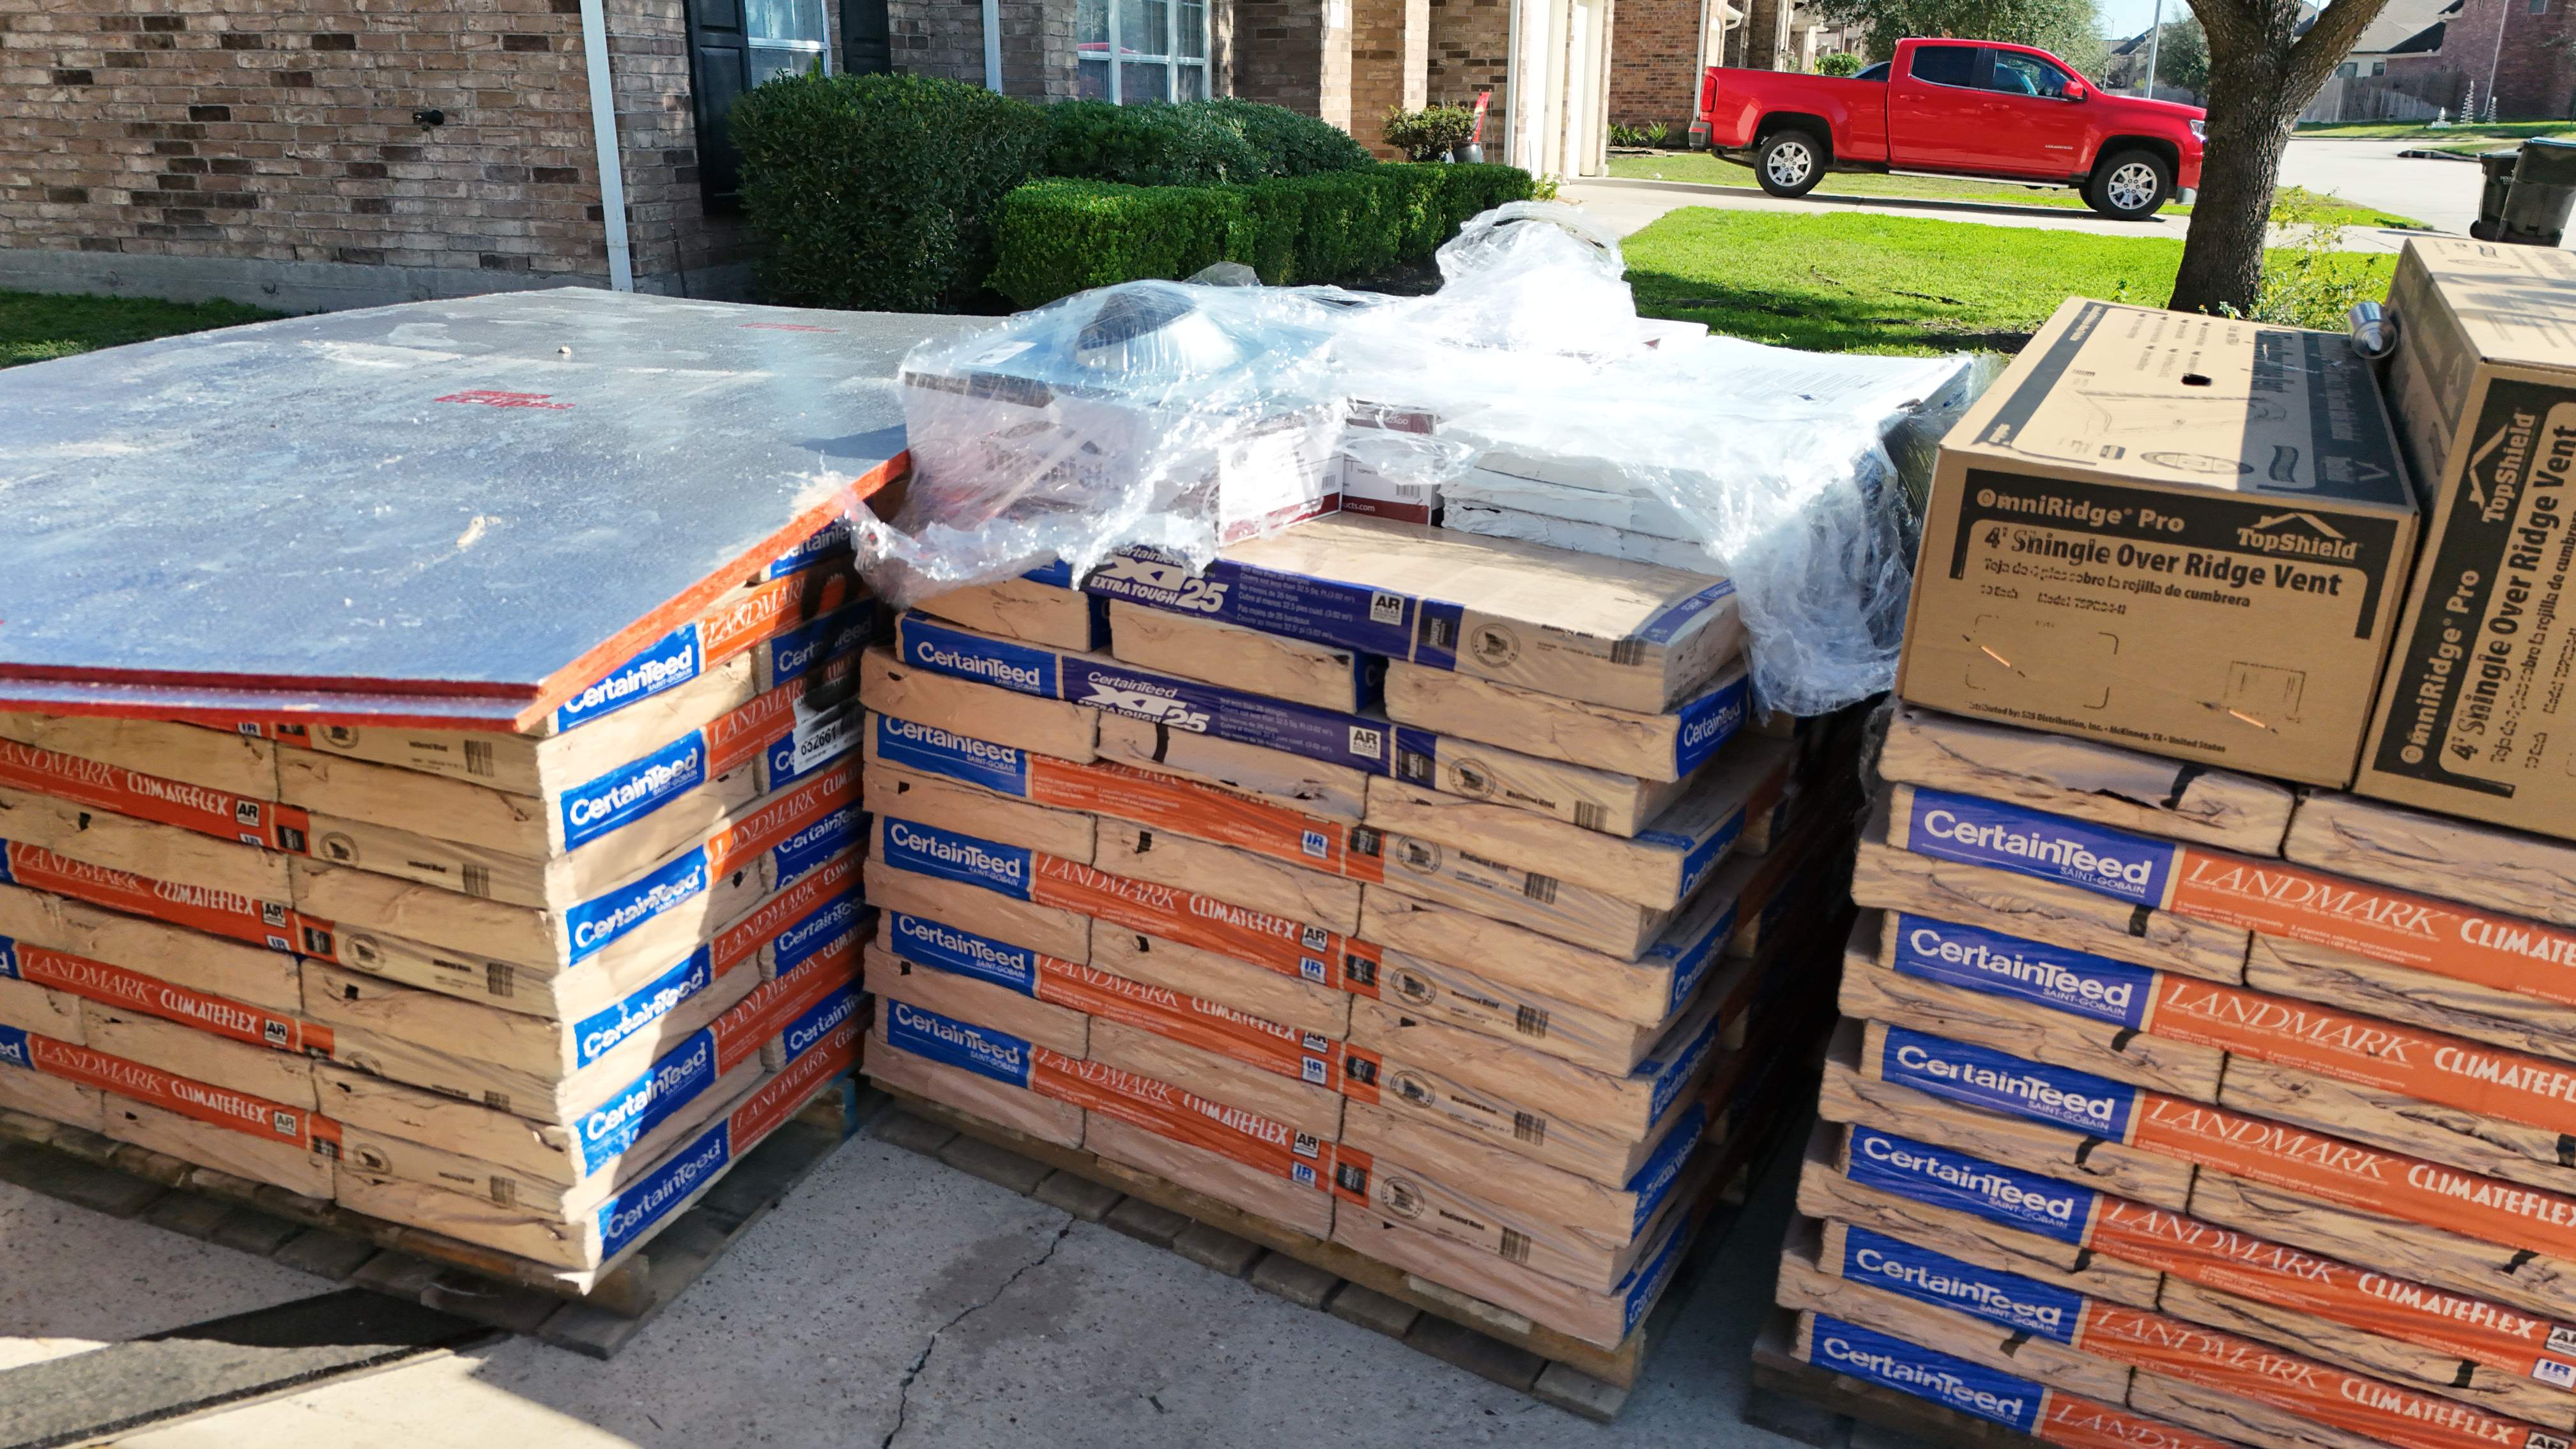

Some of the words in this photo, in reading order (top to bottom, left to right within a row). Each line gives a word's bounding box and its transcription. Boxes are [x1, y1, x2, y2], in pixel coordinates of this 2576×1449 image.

[2481, 412, 2536, 524] TopShield
[2533, 424, 2576, 489] Vent
[2138, 509, 2185, 533] Pro
[2237, 527, 2358, 561] TopShield
[2508, 496, 2559, 572] Ridge
[2013, 528, 2110, 569] Shingle
[2117, 543, 2179, 573] Over
[2184, 551, 2267, 589] Ridge
[2273, 564, 2343, 597] Vent
[2446, 571, 2480, 614] Pro
[2546, 574, 2562, 590] de
[1176, 577, 1230, 613] 25
[1376, 595, 1401, 610] AR
[2122, 578, 2162, 595] rejilla
[2165, 584, 2182, 597] de
[2184, 588, 2251, 608] cumbrera
[2488, 576, 2532, 636] Over
[564, 644, 693, 714] CertainTeed
[917, 641, 1041, 687] CertainTeed
[1087, 671, 1178, 699] CertainTeed
[2457, 640, 2511, 736] Shingle
[710, 677, 805, 746] LANDMAR
[1162, 709, 1211, 733] 25
[1353, 729, 1377, 744] AR
[0, 741, 116, 788] ANDMARK
[128, 771, 229, 816] CLIMATEFLEX
[569, 748, 698, 826] CertainTeed
[966, 752, 1016, 774] SAINT-GOBAIN
[237, 803, 259, 818] AR
[712, 786, 820, 866] LANDMARK
[1307, 832, 1324, 848] IR
[891, 823, 1021, 878] CertainTeed
[1924, 809, 2152, 887] CertainTeed
[17, 844, 146, 892] LANDMARK
[153, 879, 256, 916] CLIMATEFLEX
[264, 901, 285, 918] AR
[574, 864, 701, 948] CertainTeed
[1040, 854, 1177, 912] LANDMARK
[1188, 893, 1298, 942] CLIMATEFLEX
[2059, 866, 2145, 894] SAINT-GOBAIN
[1305, 925, 1326, 944] AR
[2186, 858, 2448, 936] LANDMARK
[2460, 917, 2576, 968] CLIMATE
[898, 916, 1025, 971] CertainTeed
[1305, 960, 1322, 976] IR
[1910, 928, 2133, 1008] CertainTeed
[26, 952, 151, 1002] LANDMARK
[160, 988, 257, 1034] CLIMATEFLEX
[1045, 956, 1178, 1008] LANDMARK
[1192, 997, 1296, 1043] CLIMATEFLEX
[2043, 987, 2127, 1020] SAINT-GOBAIN
[266, 1021, 288, 1036] AR
[894, 1003, 1021, 1065] CertainTeed
[2162, 984, 2428, 1062] LANDMARK
[2433, 1046, 2576, 1105] CLIMATEFL
[37, 1040, 165, 1092] LANDMARK
[171, 1080, 266, 1125] CLIMATEFLEX
[586, 1041, 707, 1141] CertainTeed
[1038, 1050, 1174, 1106] LANDMARK
[1307, 1058, 1322, 1074] IR
[1897, 1045, 2115, 1123] CertainTeed
[275, 1114, 296, 1128] AR
[1296, 1133, 1318, 1149] AR
[2028, 1100, 2110, 1132] SAINT-GOBAIN
[2149, 1100, 2402, 1181] LANDMARK
[607, 1138, 721, 1239] CertainTeed
[1296, 1163, 1313, 1179] IR
[1864, 1136, 2074, 1220] CertainTeed
[1988, 1195, 2070, 1230] SAINT-GOBAIN
[1855, 1248, 2062, 1327] CertainTeed
[2101, 1201, 2346, 1285] LANDMARK
[2358, 1272, 2538, 1340] CLIMATEFLEX
[1823, 1337, 2024, 1416] CertainTeed
[2096, 1308, 2331, 1390] LANDMARK
[2340, 1377, 2517, 1446] CLIMATEFLEX
[2543, 1361, 2571, 1377] IR
